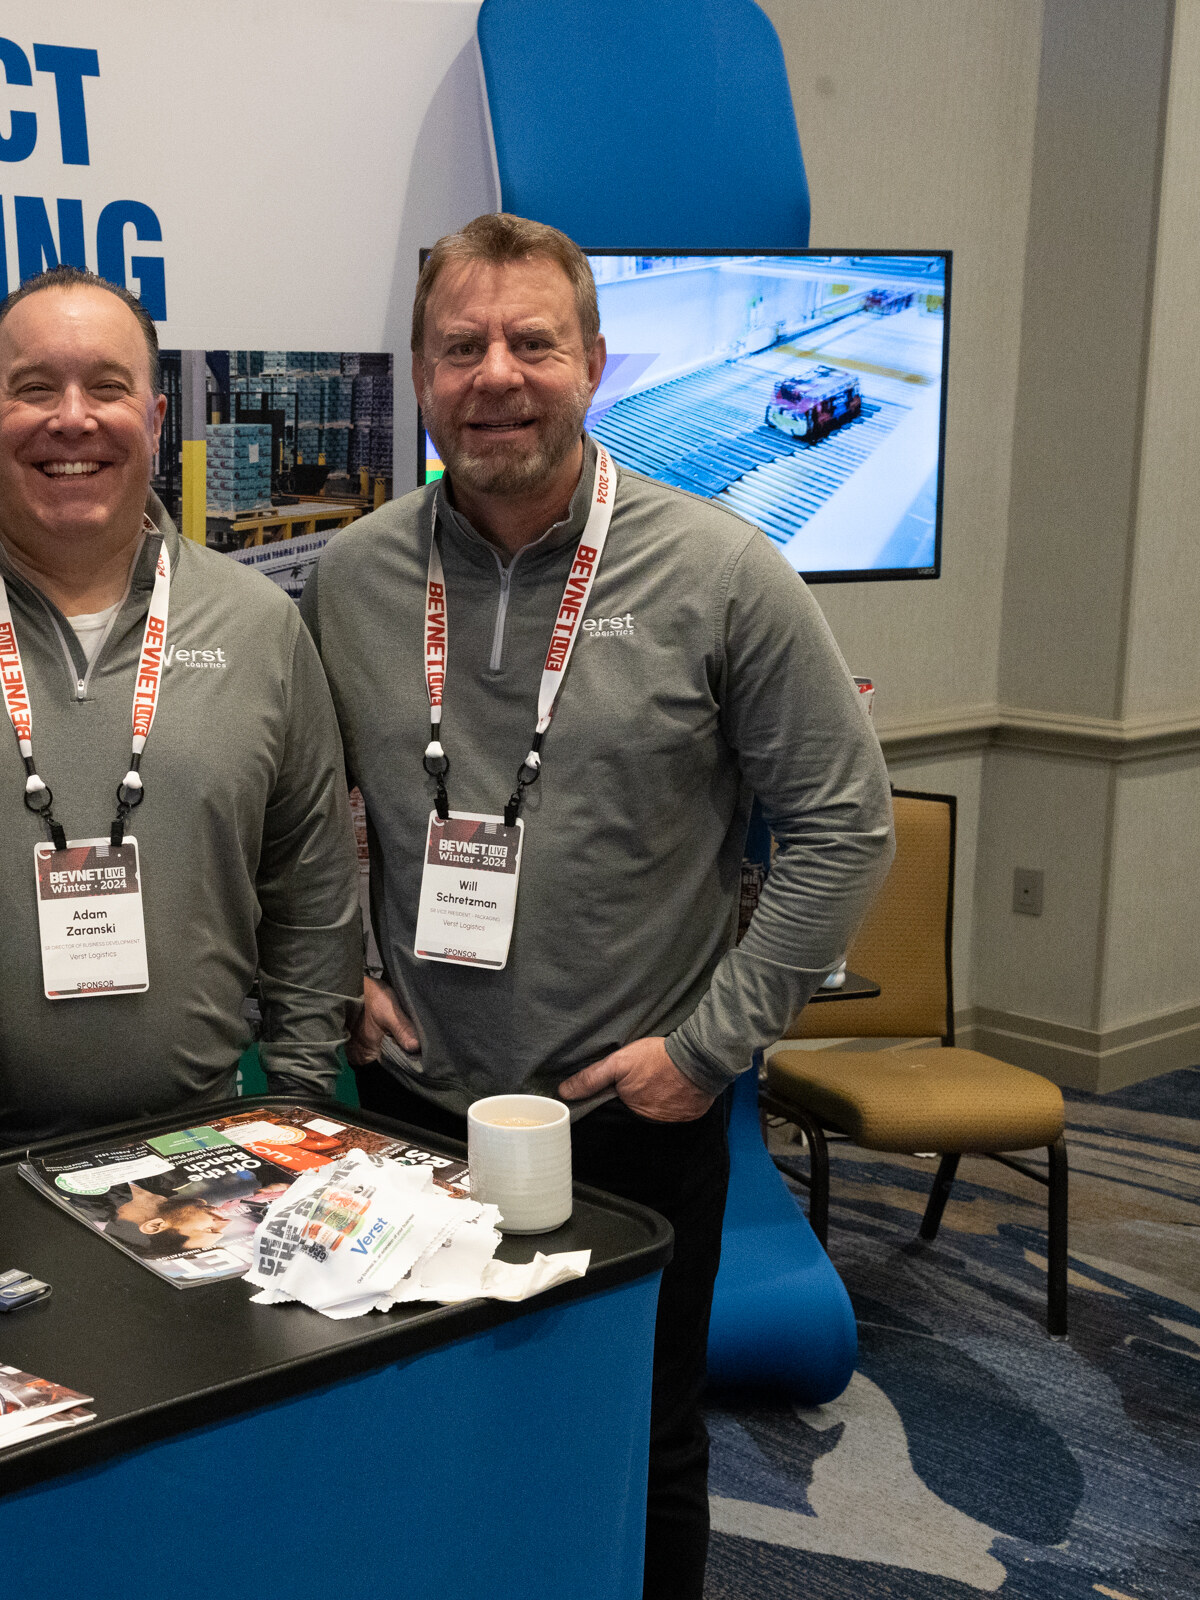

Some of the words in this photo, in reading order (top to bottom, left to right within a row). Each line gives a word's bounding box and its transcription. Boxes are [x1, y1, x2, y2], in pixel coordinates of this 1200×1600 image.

[596, 475, 610, 505] 2024
[582, 613, 634, 631] erst
[589, 629, 634, 637] LOGISTICS
[544, 635, 571, 672] LIVE
[428, 672, 445, 706] LIVE
[133, 703, 154, 738] LIVE
[488, 845, 508, 858] LIVE
[439, 851, 474, 864] Winter
[482, 856, 507, 868] 2024
[104, 866, 126, 880] LIVE
[50, 882, 92, 894] Winter
[100, 879, 127, 890] 2024
[459, 880, 478, 892] Will
[436, 892, 497, 909] Schretzman
[73, 909, 108, 920] Adam
[66, 924, 116, 936] Zaranski
[443, 920, 458, 928] Verst
[459, 922, 486, 932] Logistics
[88, 951, 117, 960] Logistics
[443, 948, 477, 958] SPONSOR
[77, 980, 114, 990] SPONSOR
[214, 1146, 238, 1154] Meet
[183, 1152, 252, 1172] Bench
[226, 1160, 262, 1174] Off
[188, 1168, 226, 1182] the
[350, 1216, 388, 1256] Verst
